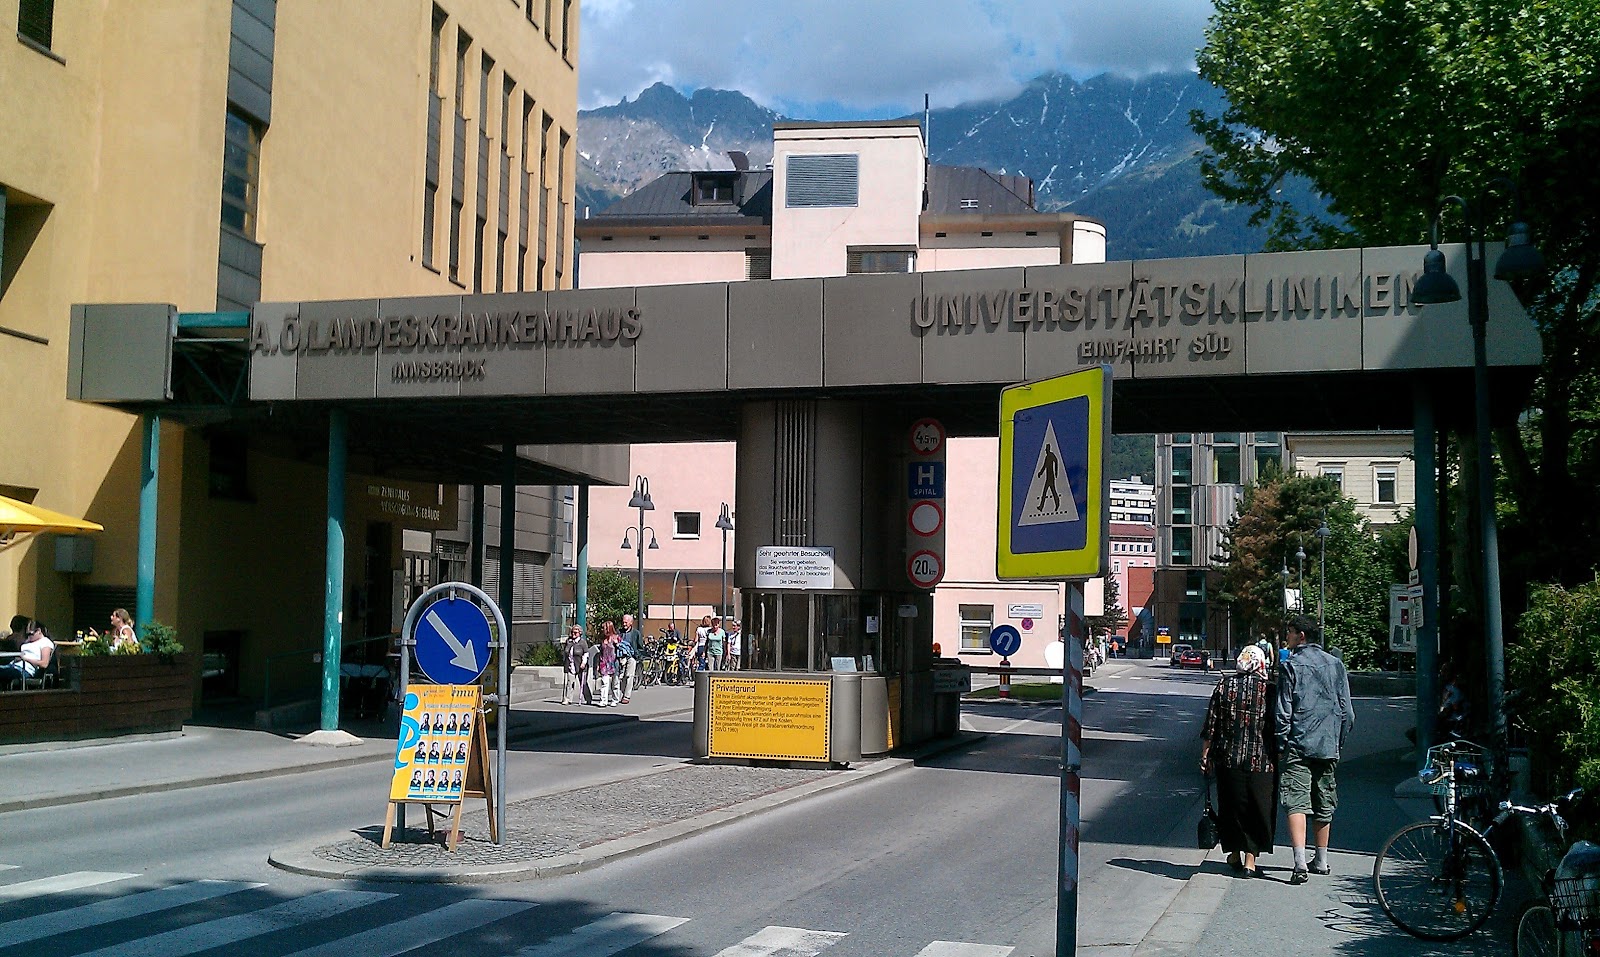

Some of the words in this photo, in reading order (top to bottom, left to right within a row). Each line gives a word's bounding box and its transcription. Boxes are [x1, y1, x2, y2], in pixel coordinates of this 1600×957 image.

[914, 269, 1422, 328] UNIVERSITÄTSKLINIKEN
[1081, 337, 1180, 358] EINFAHRT
[1193, 331, 1231, 354] SÜD
[394, 359, 486, 379] INNSBRUCK
[918, 465, 934, 485] H
[914, 488, 937, 496] SPITAL
[716, 684, 756, 693] Privatgrund
